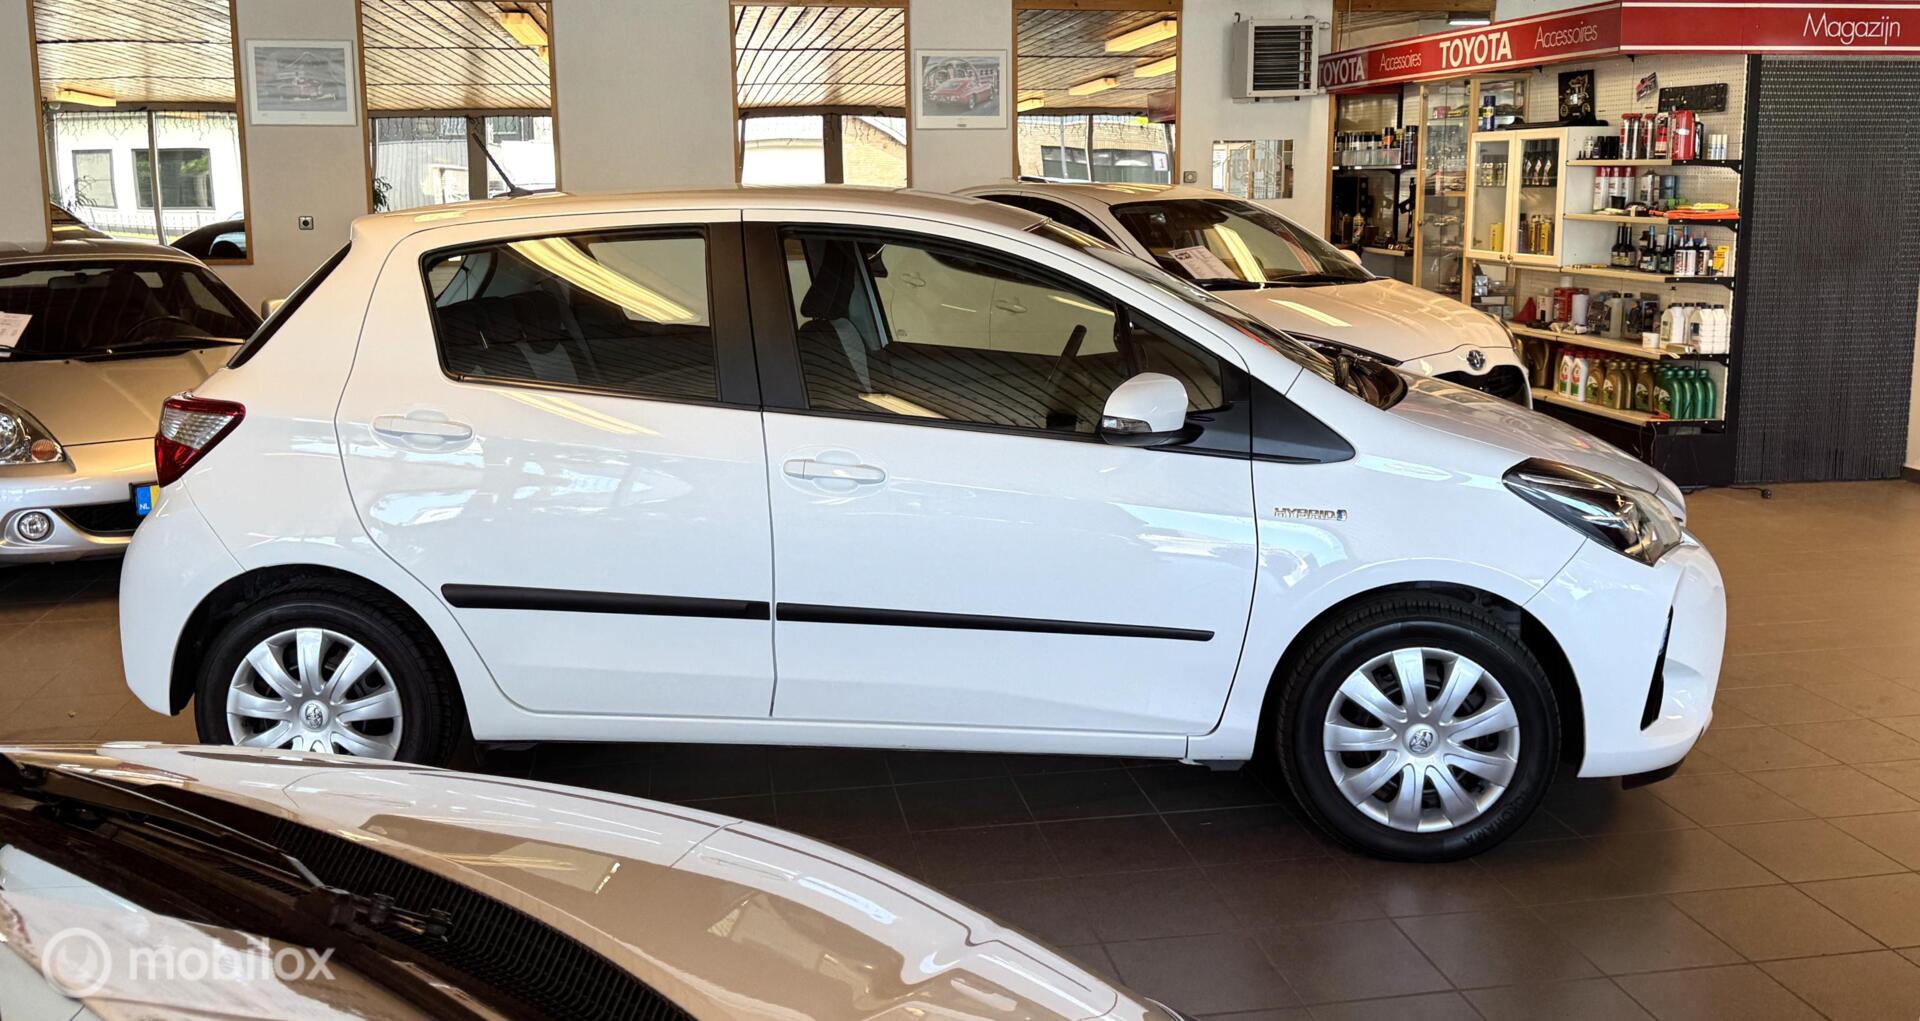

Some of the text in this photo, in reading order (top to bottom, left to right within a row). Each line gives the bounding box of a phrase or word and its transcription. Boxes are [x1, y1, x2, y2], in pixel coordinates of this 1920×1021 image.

[1803, 12, 1901, 46] Magazijn
[1318, 21, 1599, 86] TOYOTA Accessoires TOYOTA Accessoires
[1274, 507, 1336, 520] HYBRID
